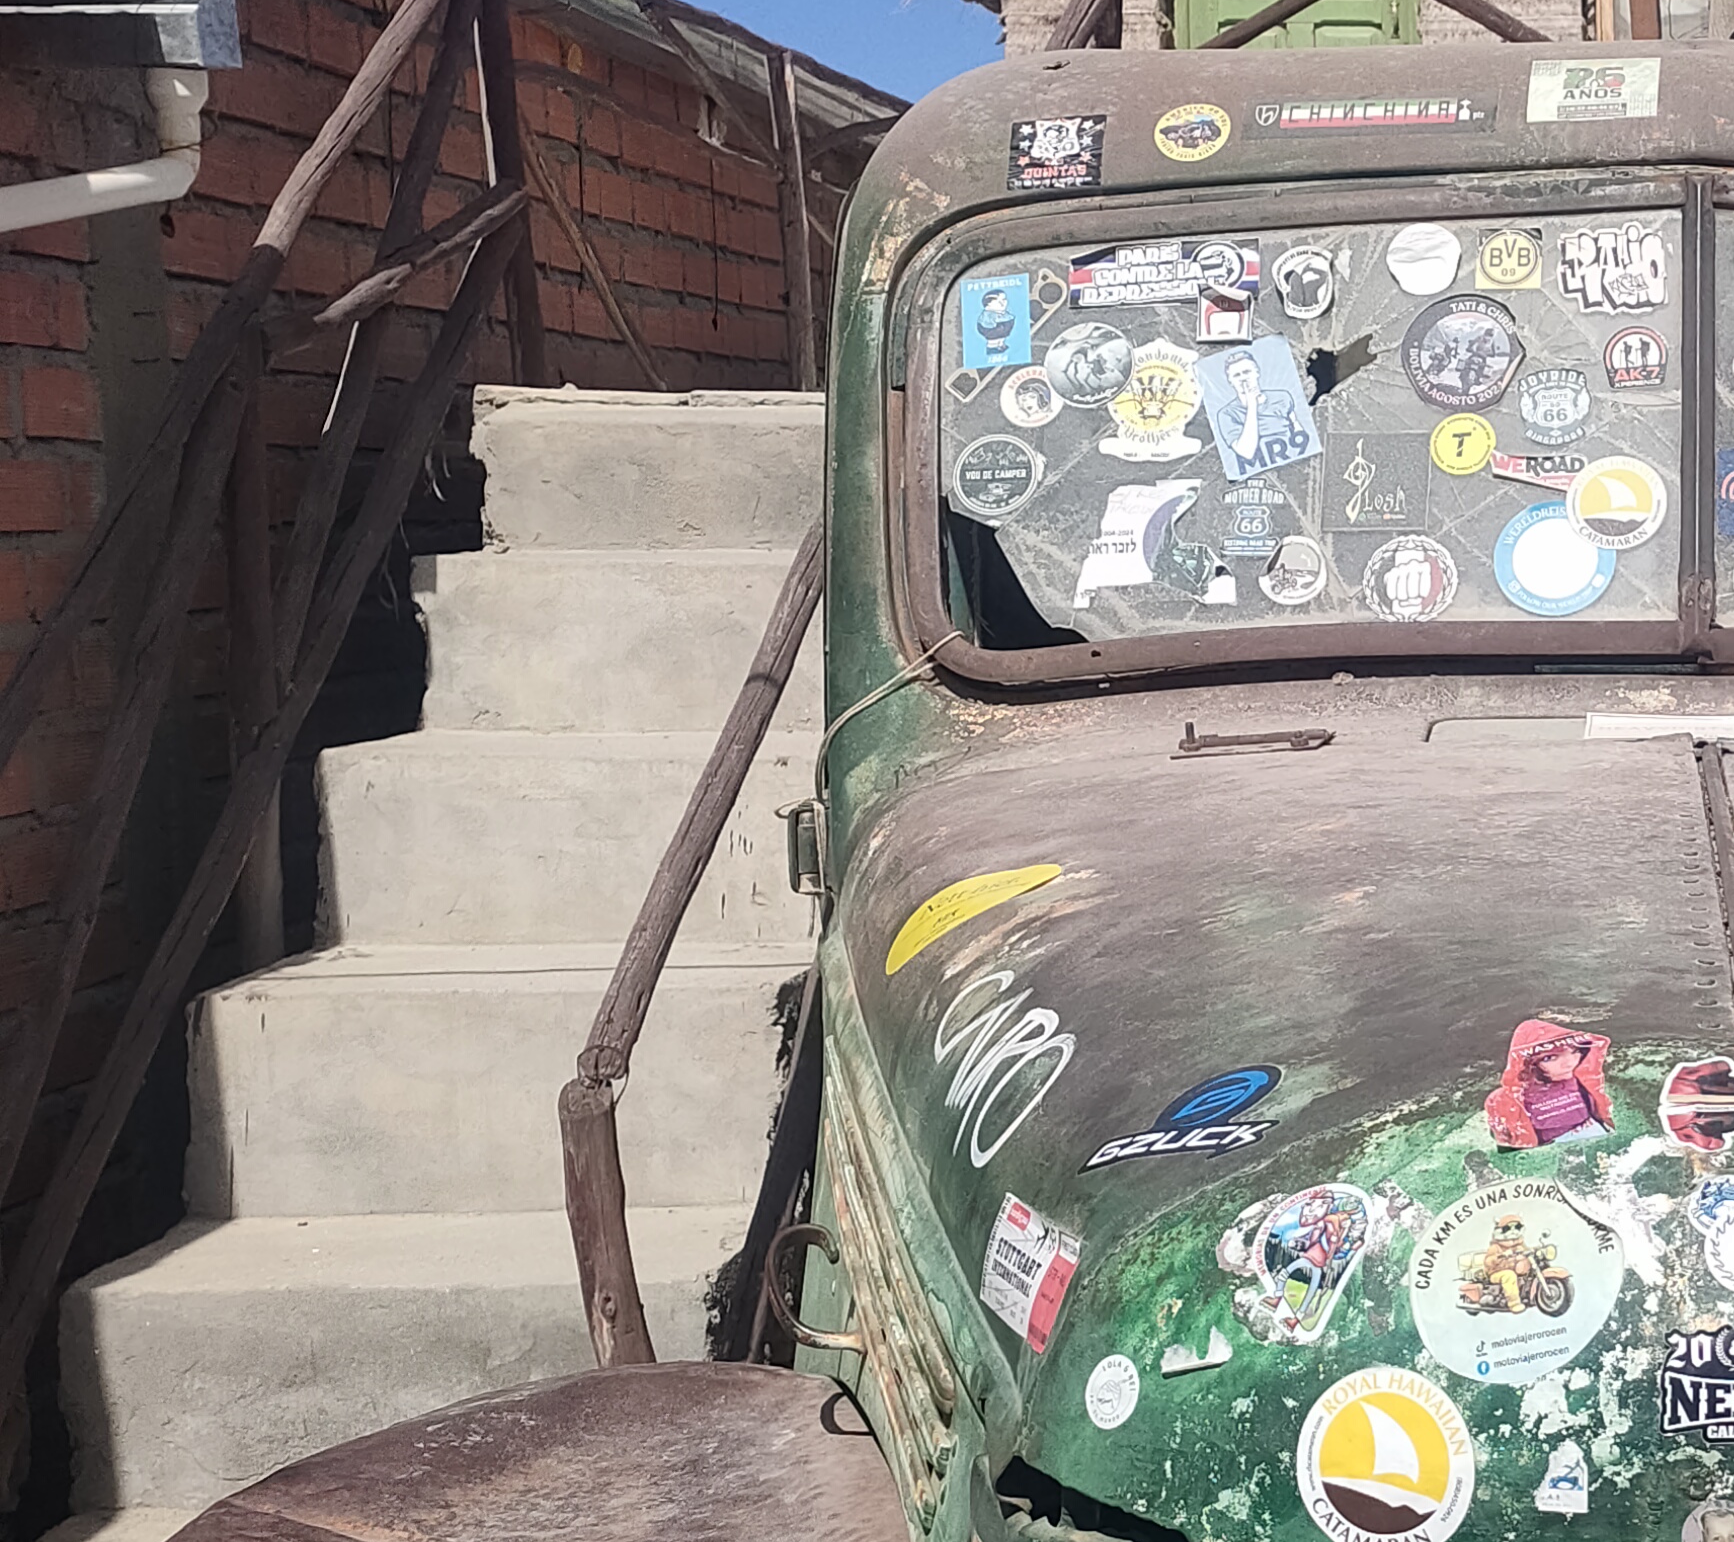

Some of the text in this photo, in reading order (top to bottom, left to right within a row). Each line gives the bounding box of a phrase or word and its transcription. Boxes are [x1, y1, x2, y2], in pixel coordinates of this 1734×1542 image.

[1563, 85, 1623, 101] AÑOS
[1021, 164, 1087, 179] QUINTAS
[1489, 238, 1531, 267] BVB
[1176, 261, 1204, 280] LA
[1501, 267, 1516, 277] 09
[1449, 301, 1516, 335] TATI & CHRIS
[1409, 347, 1476, 406] BOLIVIA AGOSTO
[1519, 370, 1586, 392] JOYRIDE
[1614, 367, 1661, 382] AK-7
[1543, 408, 1568, 422] 66
[1236, 431, 1310, 475] MR9
[982, 470, 993, 479] DE
[994, 468, 1027, 479] CAMPER
[1247, 479, 1265, 488] THE
[1224, 488, 1285, 505] MOTHER ROAD
[1240, 518, 1264, 533] 66
[1579, 525, 1648, 547] CATAMARAN
[1520, 1033, 1592, 1057] WAS HERE
[1260, 1224, 1269, 1236] DE
[1267, 1212, 1280, 1224] UN
[1280, 1186, 1328, 1213] CONTINENTE
[1415, 1189, 1508, 1290] CADA KM ES UNA
[995, 1237, 1042, 1280] STUTTGART
[991, 1258, 1032, 1298] INTERNATIONAL
[1667, 1334, 1713, 1368] 20
[1322, 1373, 1469, 1457] ROYAL HAWAIIAN
